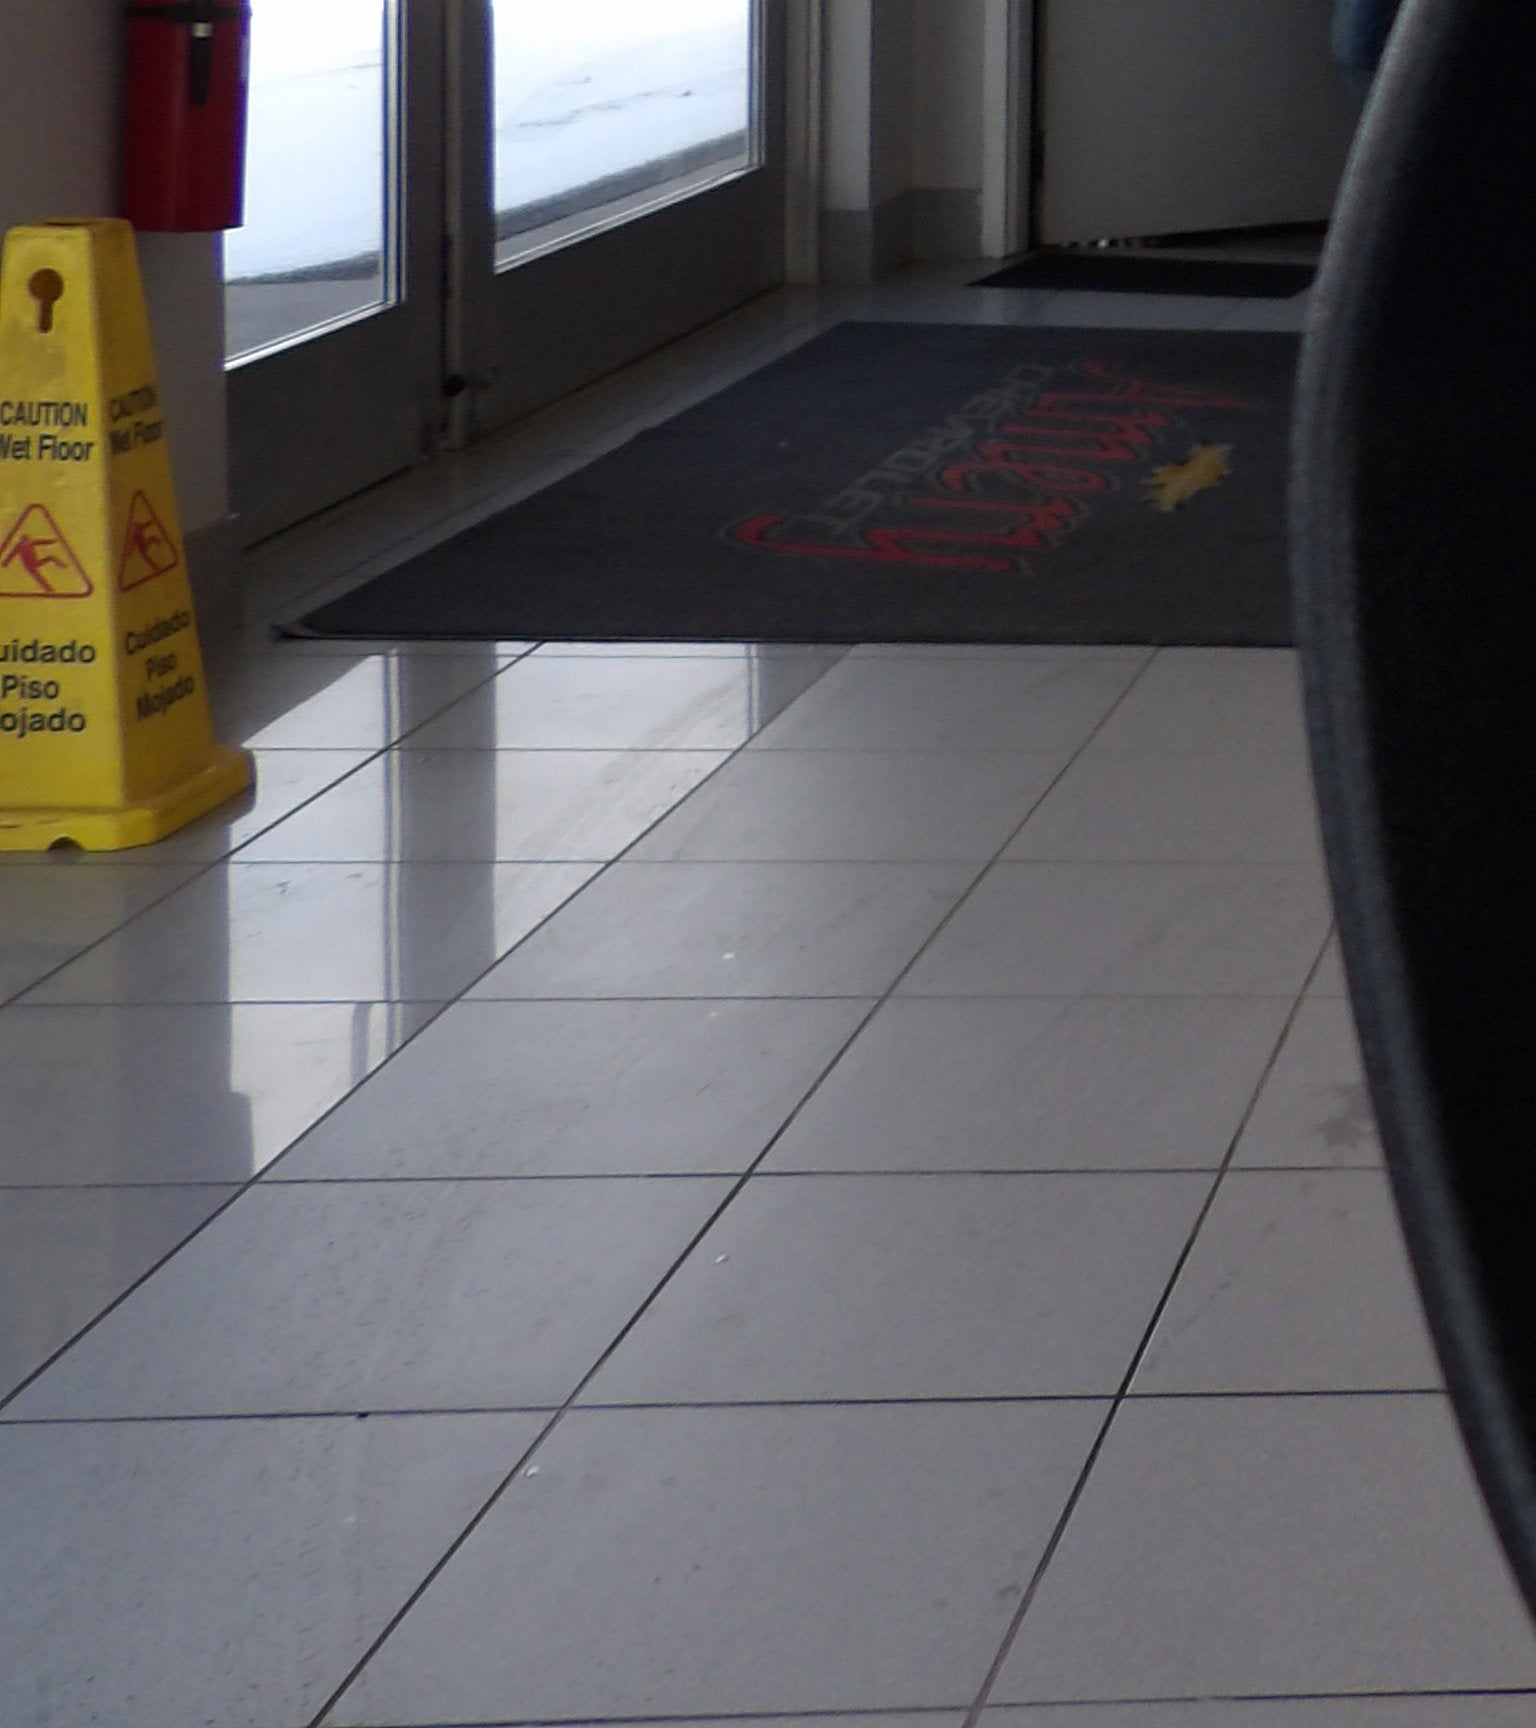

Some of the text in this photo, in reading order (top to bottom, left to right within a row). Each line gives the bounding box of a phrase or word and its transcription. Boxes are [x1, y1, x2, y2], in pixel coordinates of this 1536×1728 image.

[0, 401, 88, 427] CAUTION
[38, 435, 95, 461] Floor
[800, 362, 1058, 535] CHEVROLET
[732, 359, 1257, 572] Amery
[0, 639, 96, 664] uidado
[2, 674, 60, 700] Piso
[0, 707, 86, 739] ojado
